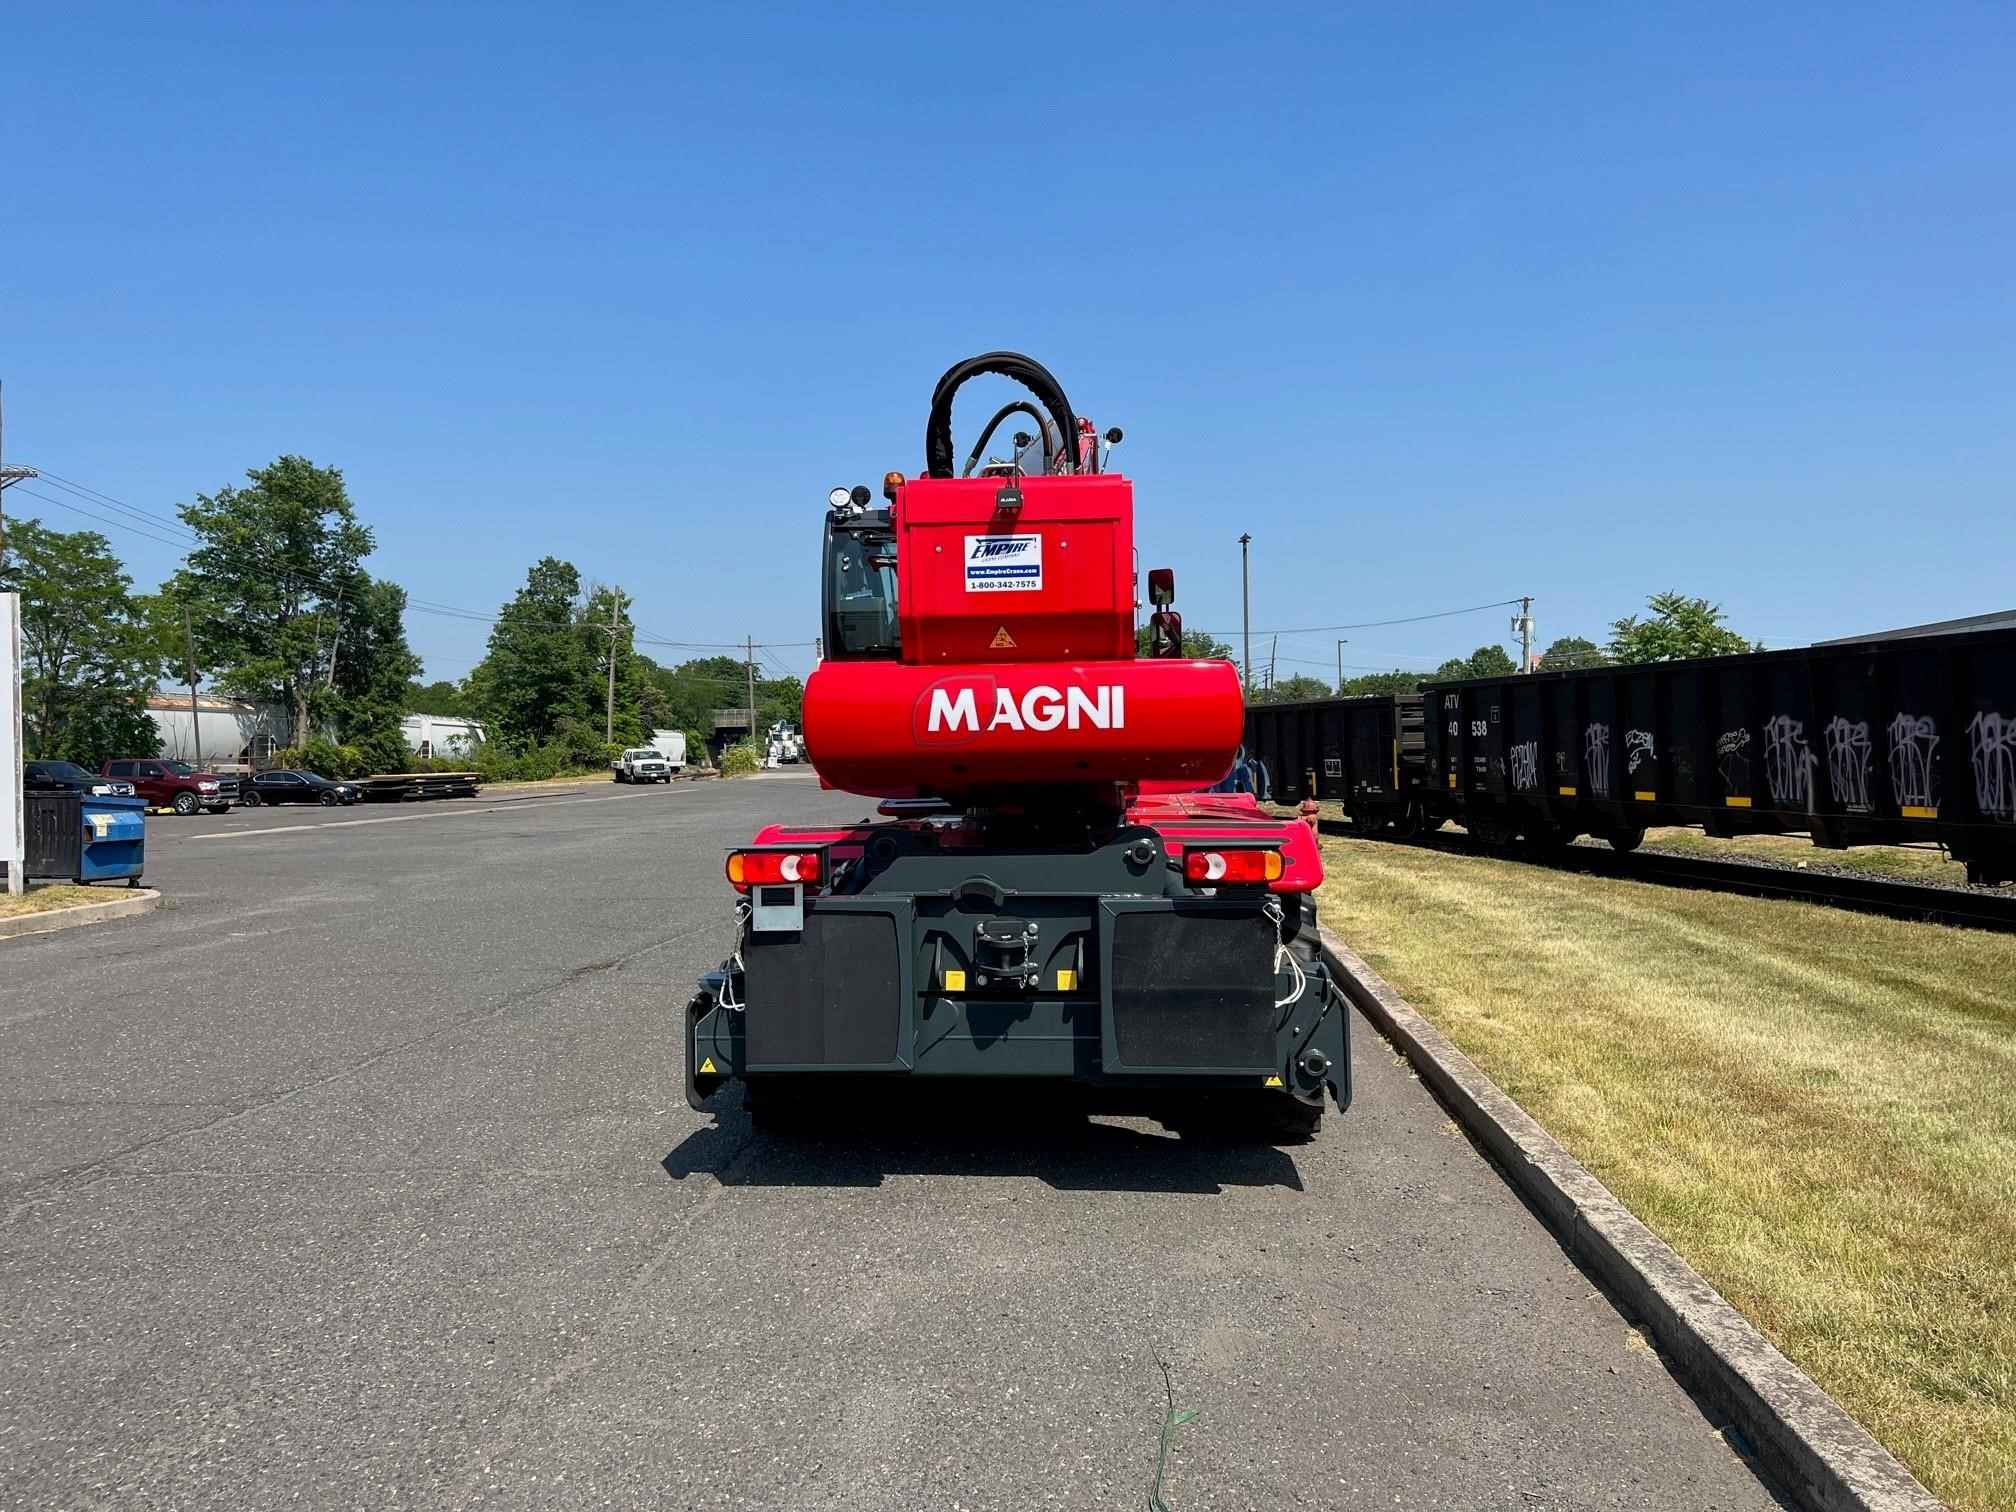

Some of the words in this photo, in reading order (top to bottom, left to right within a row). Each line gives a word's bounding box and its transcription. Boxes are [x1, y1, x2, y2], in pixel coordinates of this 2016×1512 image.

[970, 541, 1031, 560] EMPIRE
[970, 580, 1037, 589] 1-800-342-7575
[927, 685, 1125, 732] MAGNI
[1471, 720, 1487, 736] 538
